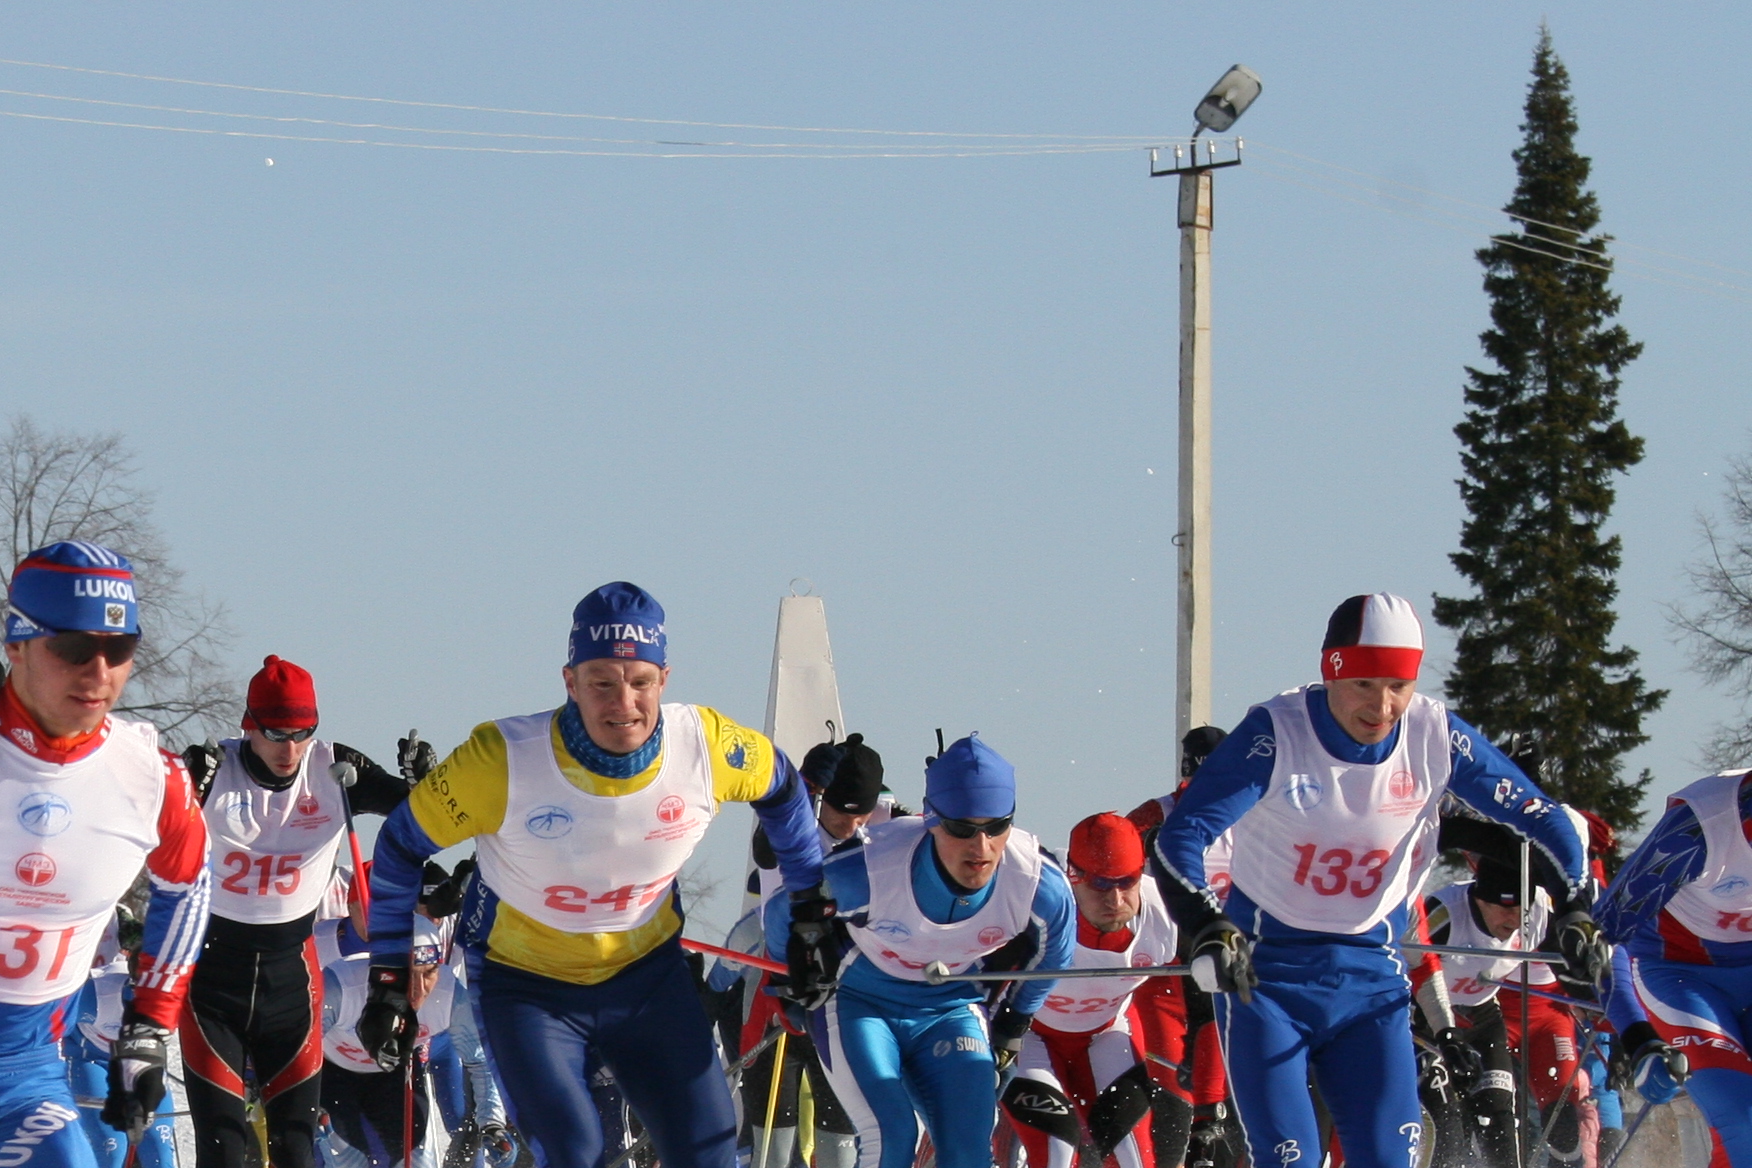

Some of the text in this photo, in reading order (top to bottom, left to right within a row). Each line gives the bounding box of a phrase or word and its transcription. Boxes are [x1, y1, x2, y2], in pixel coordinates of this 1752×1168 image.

[437, 764, 470, 825] GORE
[221, 851, 303, 896] 215
[1293, 843, 1391, 898] 133
